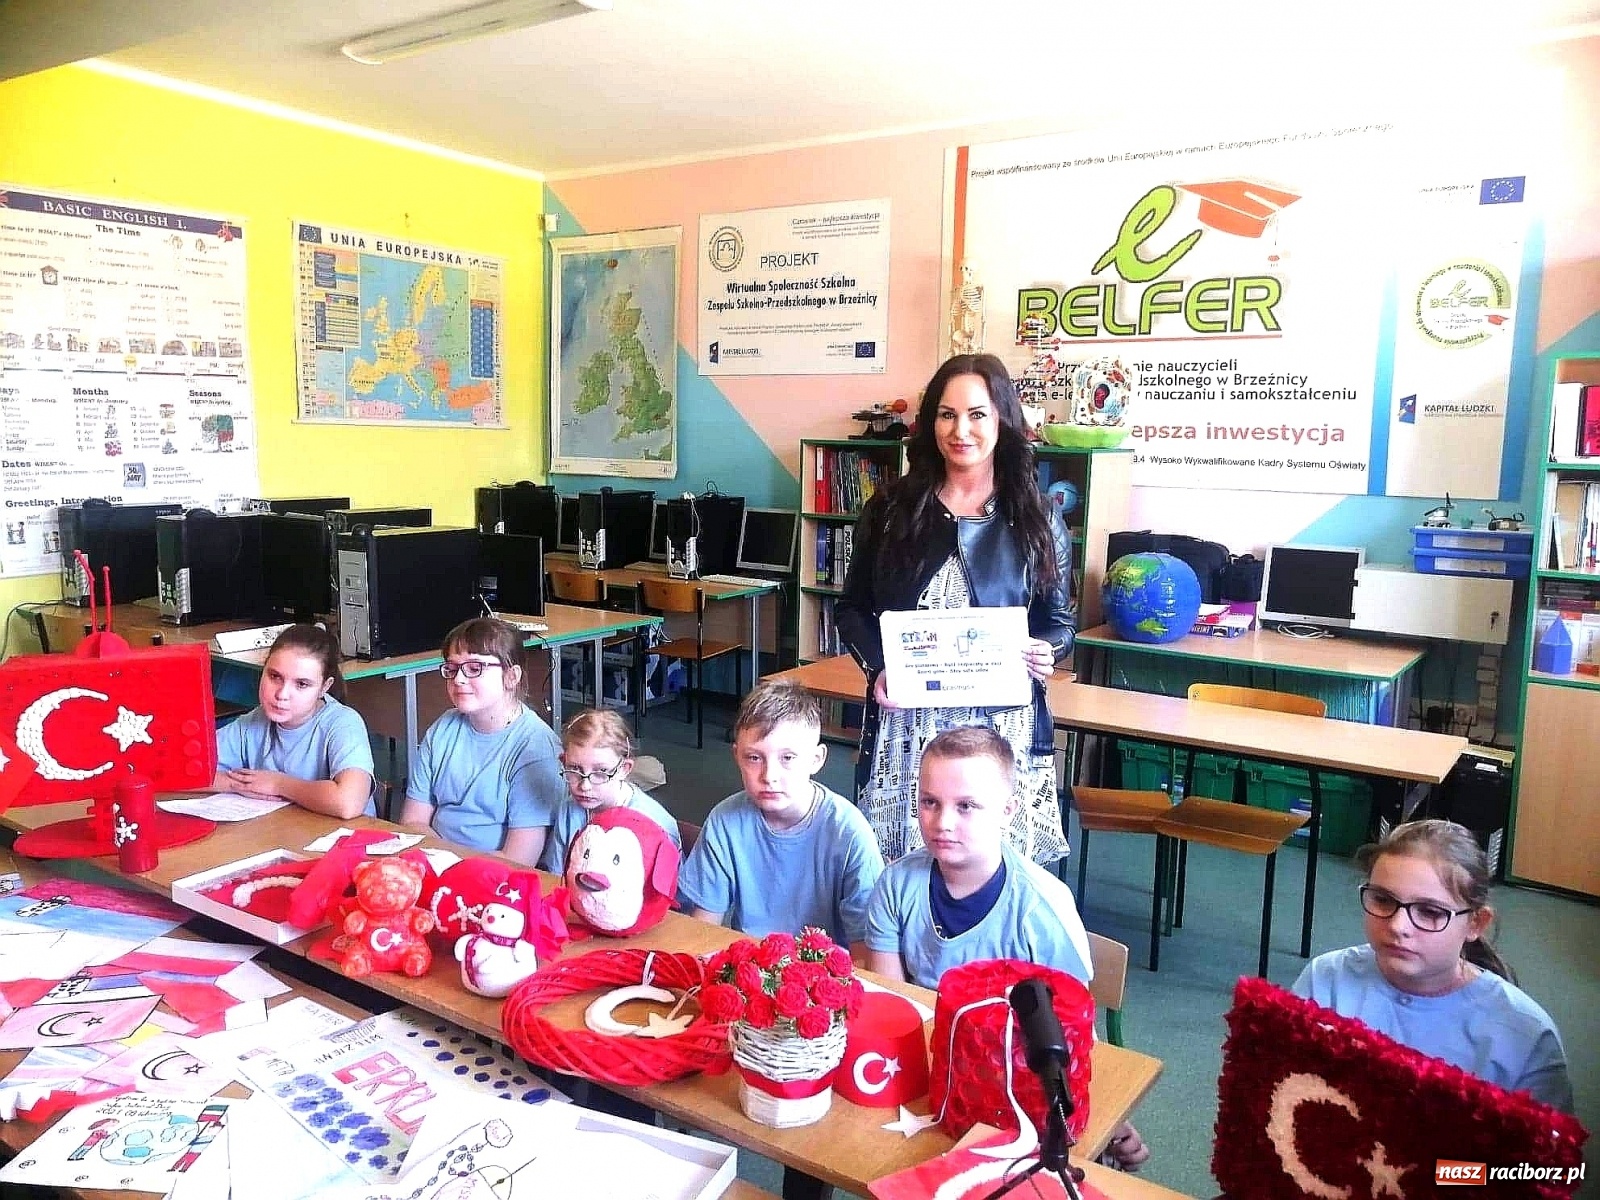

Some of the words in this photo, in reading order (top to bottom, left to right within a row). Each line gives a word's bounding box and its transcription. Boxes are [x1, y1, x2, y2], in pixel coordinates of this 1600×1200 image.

[43, 200, 91, 218] BASIC
[102, 208, 169, 227] ENGLISH
[96, 224, 115, 234] The
[116, 226, 141, 237] Time
[330, 232, 366, 249] UNIA
[376, 240, 462, 266] EUROPEJSKA
[760, 252, 820, 269] PROJEKT
[726, 280, 766, 294] Wirtualna
[768, 278, 818, 294] Społeczność
[820, 276, 856, 290] Szkolna
[707, 300, 735, 313] Zespołu
[736, 296, 827, 309] Szkolno-Przedszkolnego
[838, 292, 878, 307] Brzeźnicy
[1016, 276, 1282, 341] BELFER
[1158, 359, 1238, 374] nauczycieli
[1216, 376, 1228, 386] w
[1234, 372, 1308, 388] Brzeźnicy
[72, 387, 109, 396] Months
[189, 390, 222, 398] Seasons
[1145, 388, 1216, 400] nauczaniu
[1220, 388, 1224, 400] i
[1230, 387, 1357, 400] samokształceniu
[1131, 425, 1196, 442] epsza
[1206, 422, 1345, 446] inwestycja
[2, 460, 32, 468] Dates
[1150, 455, 1182, 466] Wysoko
[1184, 456, 1256, 467] Wykwalifikowane
[1258, 458, 1284, 469] Kadry
[1286, 459, 1326, 470] Systemu
[1328, 460, 1367, 472] Oświaty
[5, 499, 58, 510] Greetings,
[910, 781, 918, 819] Therapy
